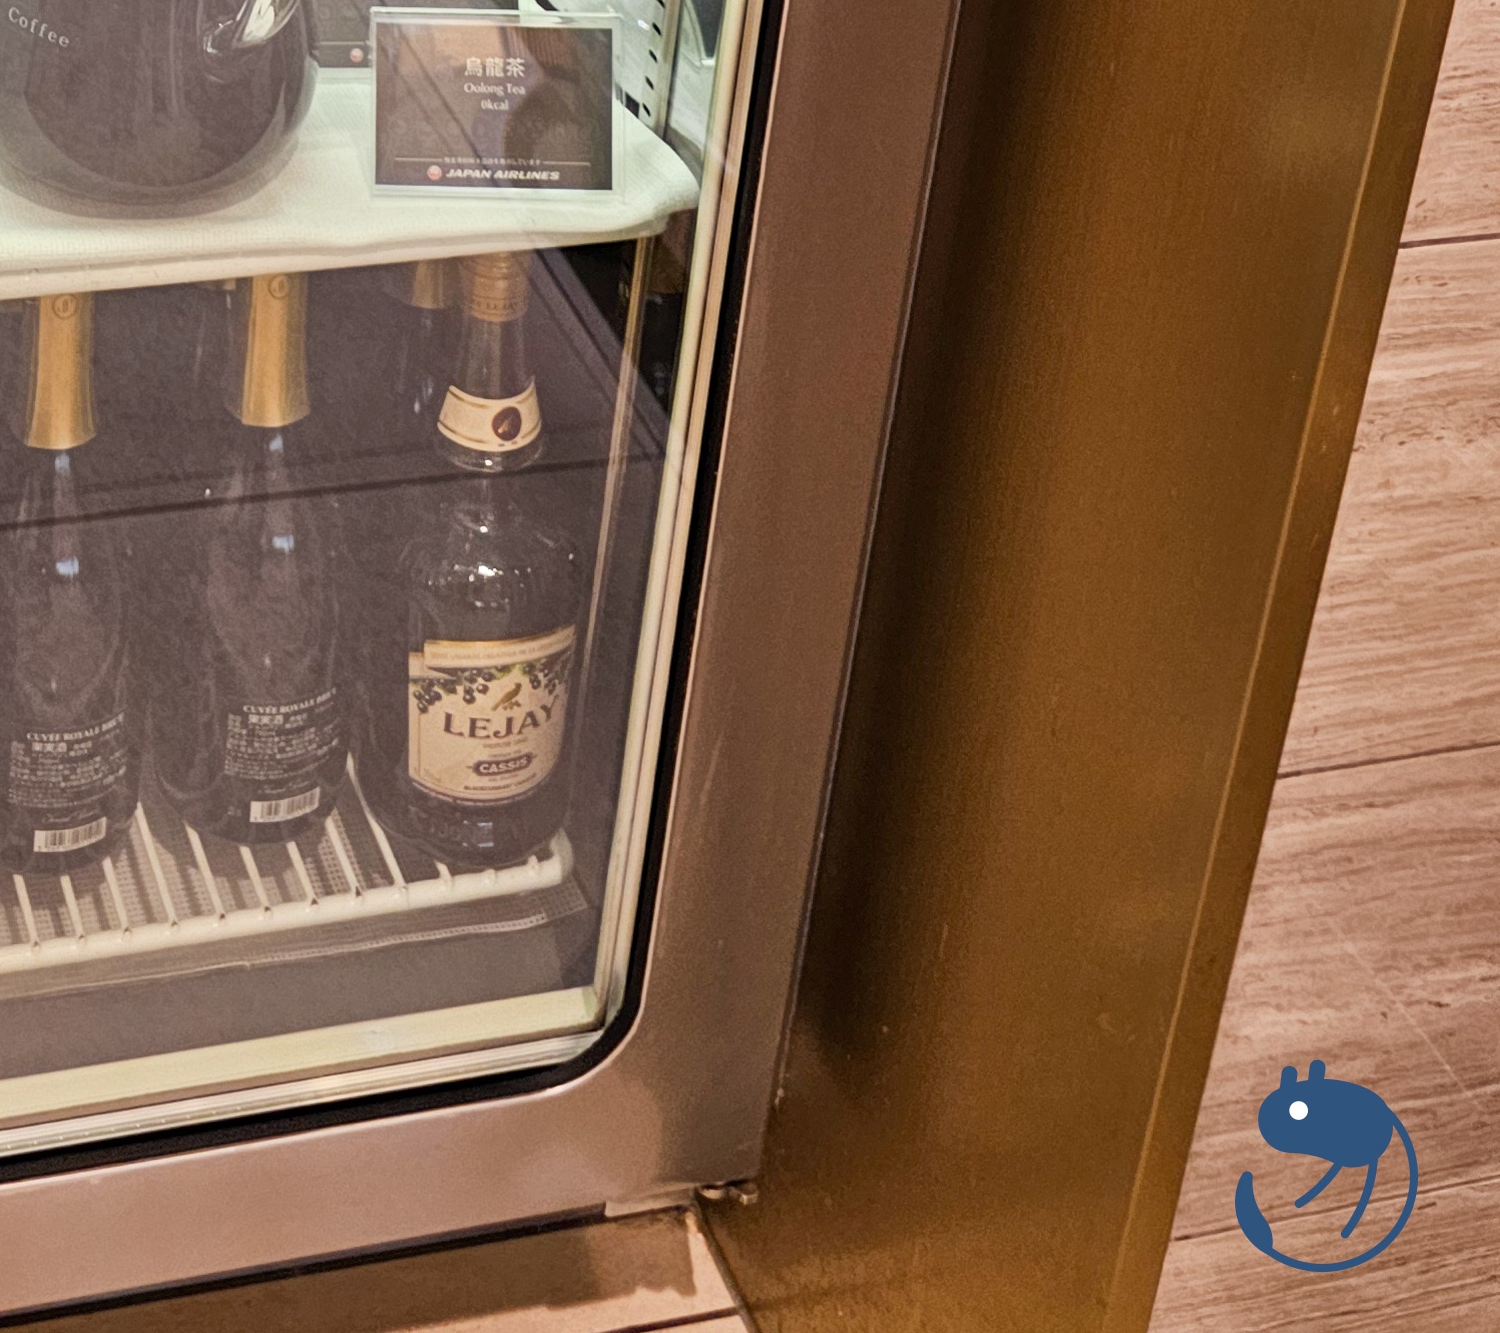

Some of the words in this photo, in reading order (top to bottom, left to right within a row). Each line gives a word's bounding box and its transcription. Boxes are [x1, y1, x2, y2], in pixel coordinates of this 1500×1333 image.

[8, 6, 70, 48] Coffee
[463, 82, 505, 97] Oolong
[507, 83, 526, 95] Tea
[480, 99, 509, 111] 0kcal
[445, 168, 492, 179] JAPAN
[493, 169, 560, 181] AIRLINES
[443, 693, 560, 739] LEJAY
[479, 756, 529, 774] CASSIS
